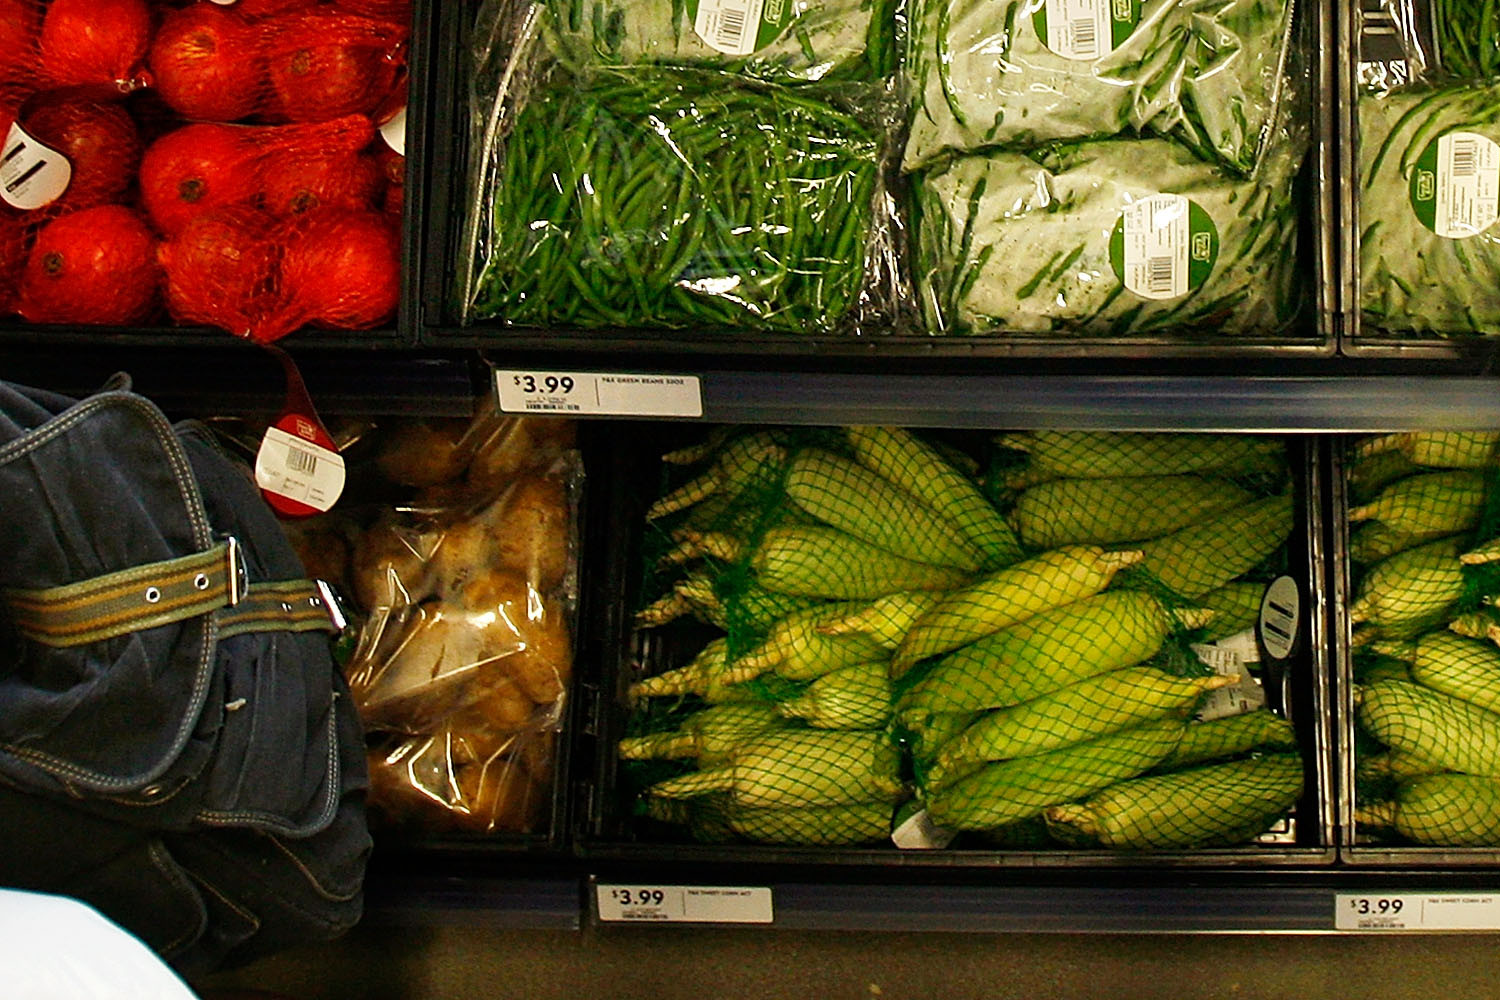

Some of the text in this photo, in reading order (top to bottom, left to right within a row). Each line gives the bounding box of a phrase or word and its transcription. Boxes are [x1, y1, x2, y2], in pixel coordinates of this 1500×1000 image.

[513, 375, 575, 394] $3.99
[612, 889, 664, 906] $3.99
[1351, 898, 1404, 915] $3.99
